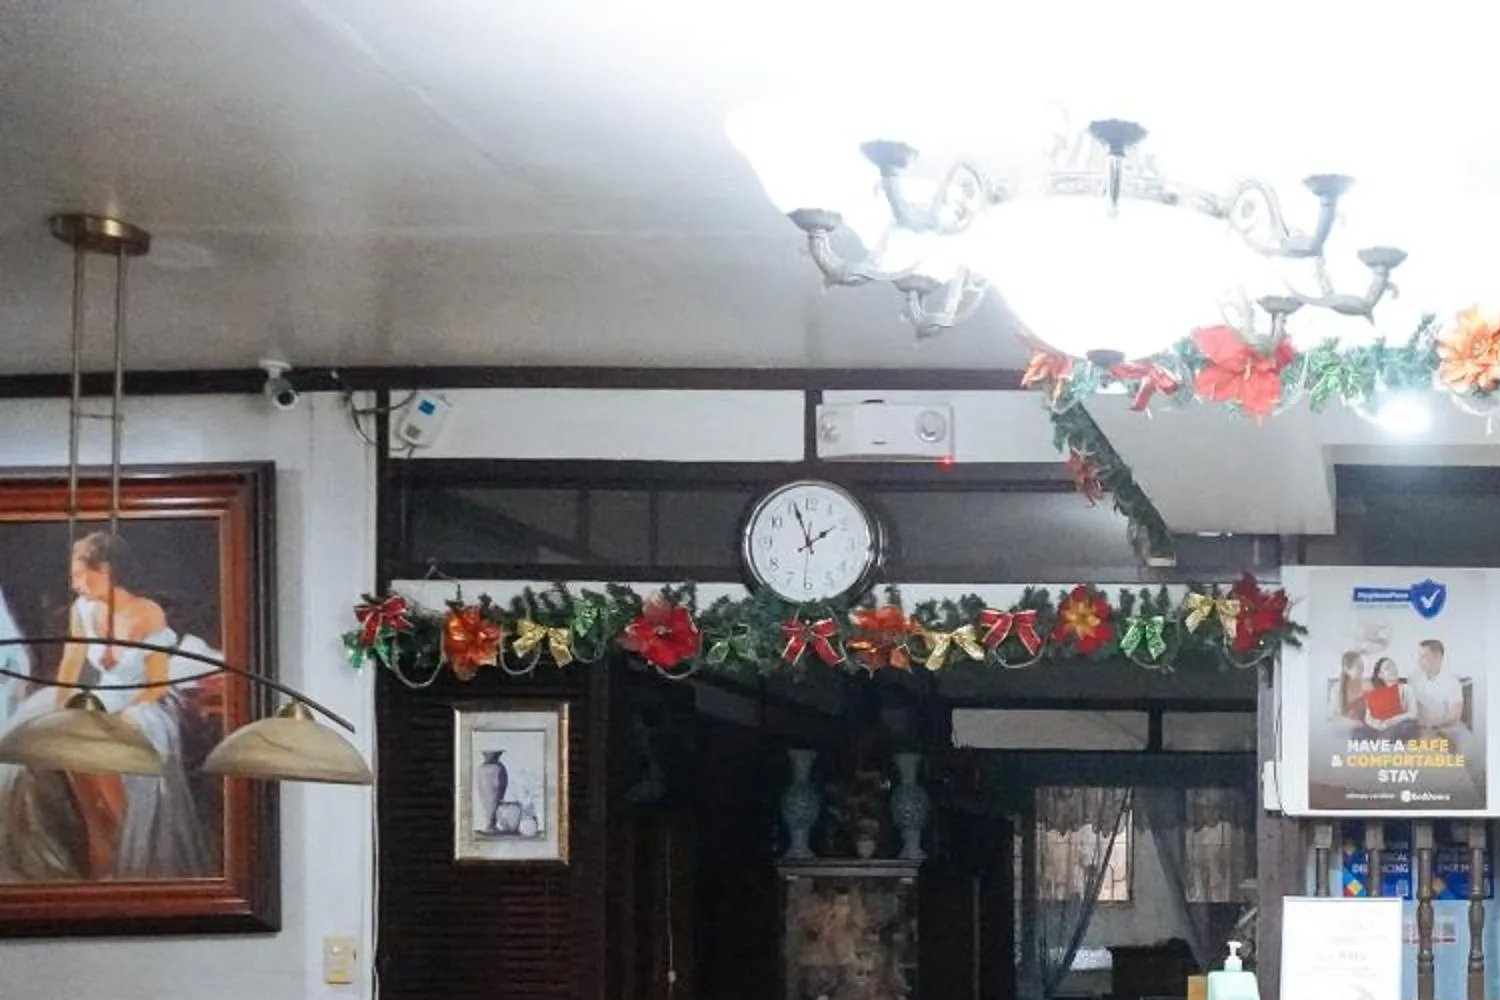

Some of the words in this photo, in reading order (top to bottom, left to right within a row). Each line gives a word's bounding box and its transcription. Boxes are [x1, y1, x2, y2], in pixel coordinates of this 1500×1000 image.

[804, 497, 818, 511] 12
[1346, 738, 1391, 753] HAVE
[1393, 738, 1405, 753] A
[1407, 738, 1449, 752] SAFE
[1331, 754, 1343, 768] &
[1346, 753, 1466, 768] COMFORTABLE
[1377, 768, 1420, 784] STAY
